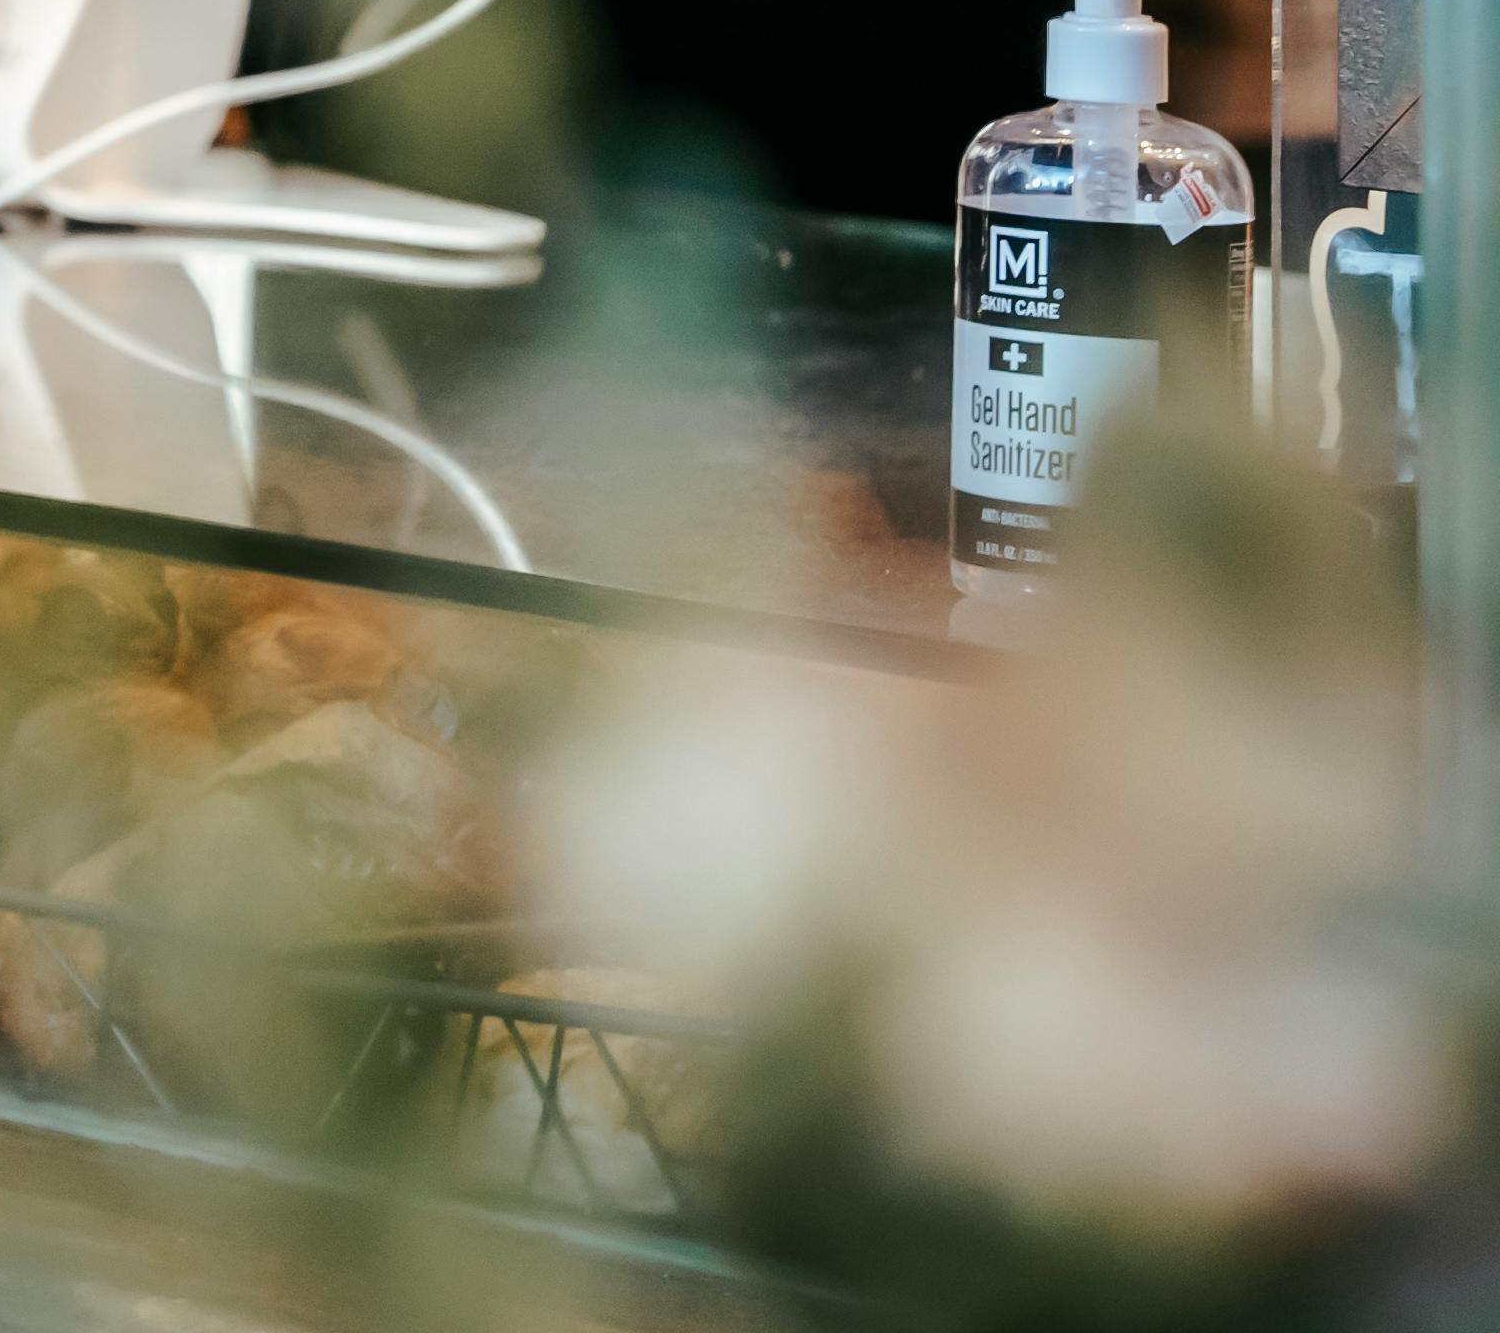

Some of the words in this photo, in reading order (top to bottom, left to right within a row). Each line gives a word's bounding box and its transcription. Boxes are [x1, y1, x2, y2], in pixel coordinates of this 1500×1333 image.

[980, 294, 1012, 314] SKIN
[1014, 299, 1060, 320] CARE
[971, 384, 1000, 427] Gel
[1008, 390, 1077, 437] Hand
[970, 430, 1077, 483] Sanitizer
